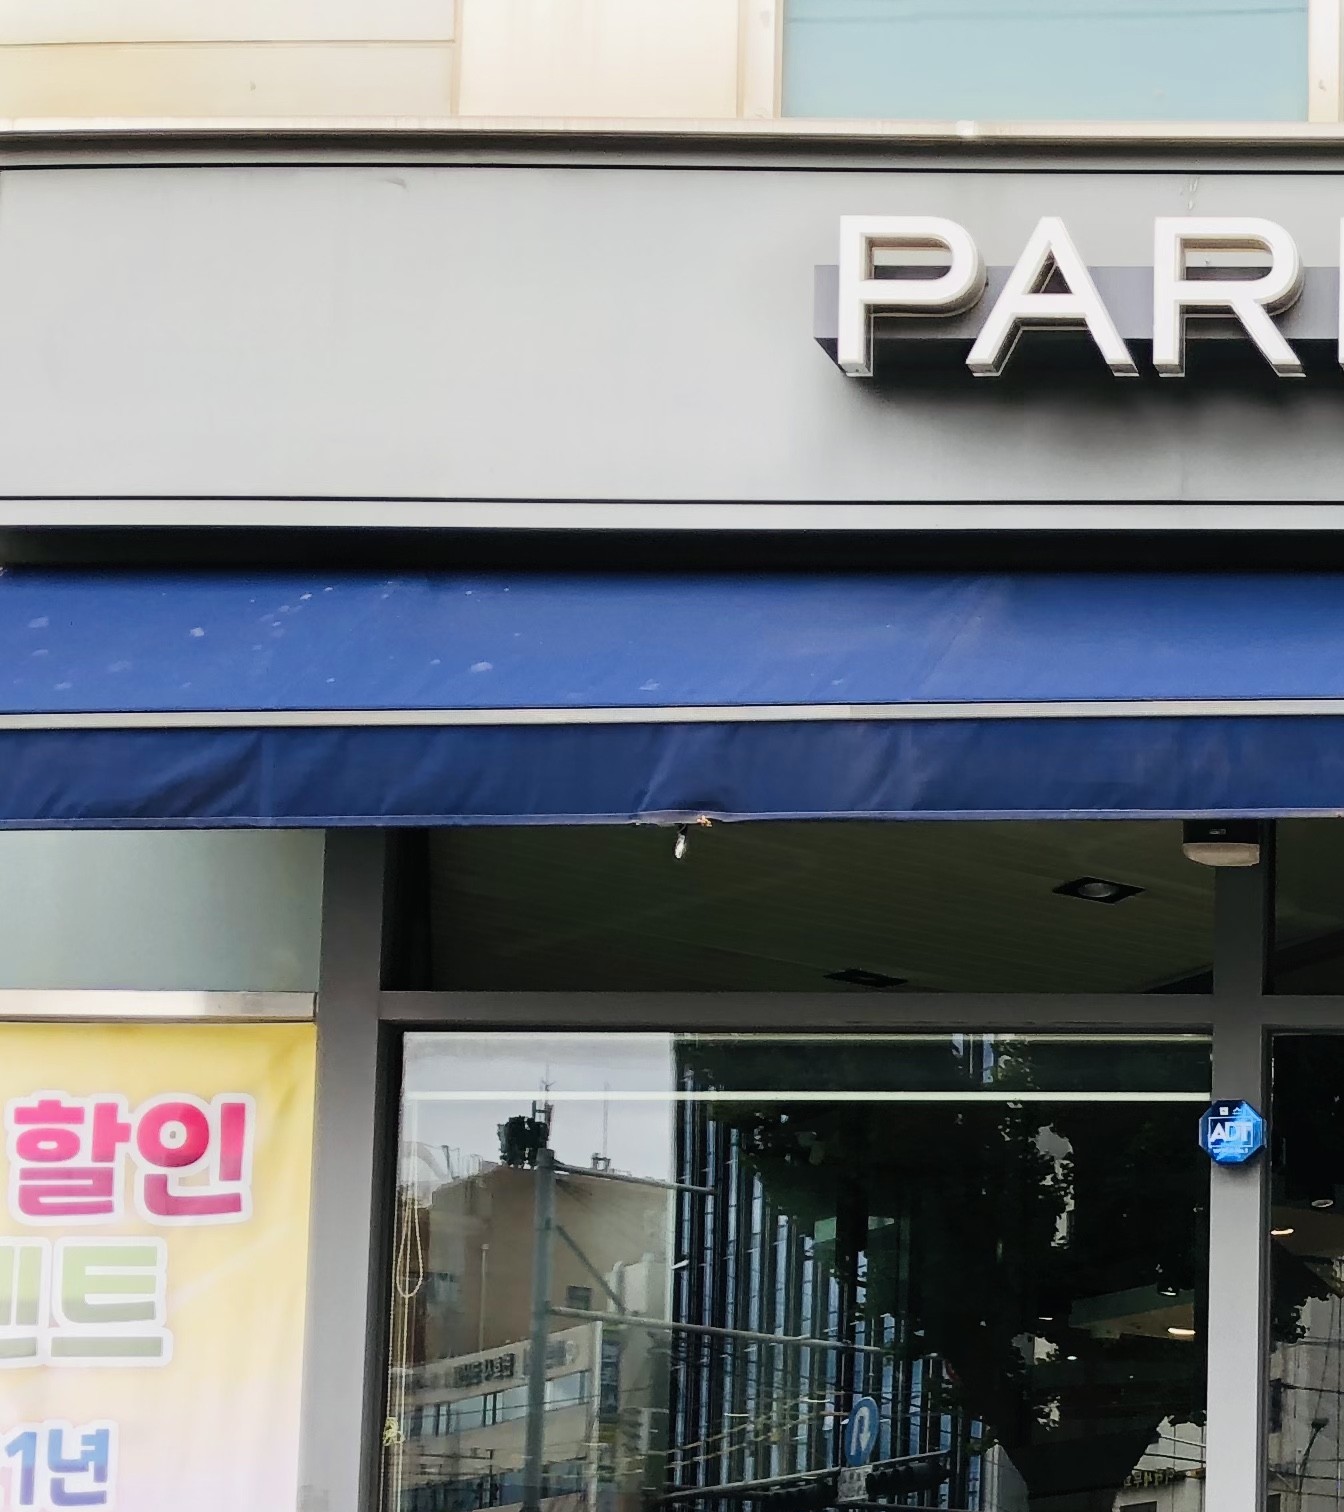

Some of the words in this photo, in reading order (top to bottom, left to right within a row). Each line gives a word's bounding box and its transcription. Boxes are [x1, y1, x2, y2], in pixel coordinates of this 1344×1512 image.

[13, 1098, 248, 1218] 할인
[1209, 1121, 1253, 1143] ADT
[4, 1428, 110, 1506] 1년
